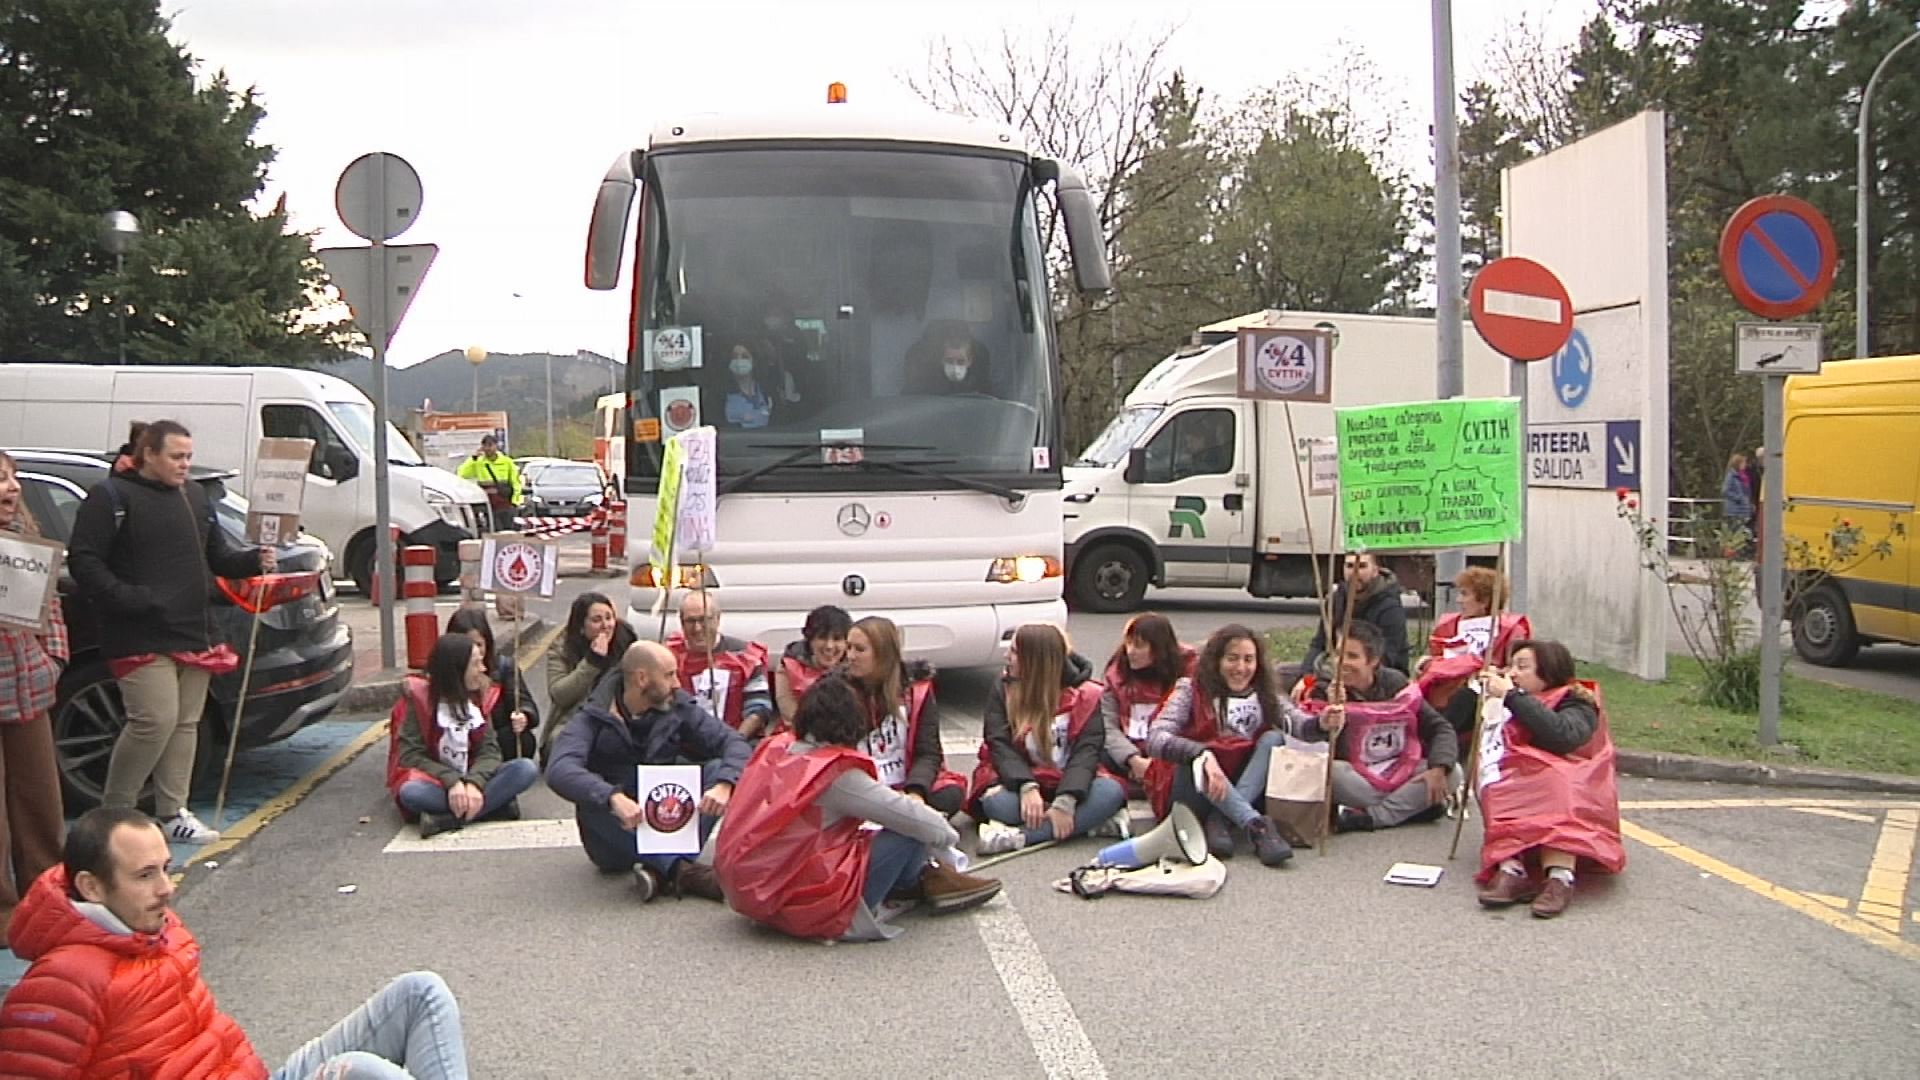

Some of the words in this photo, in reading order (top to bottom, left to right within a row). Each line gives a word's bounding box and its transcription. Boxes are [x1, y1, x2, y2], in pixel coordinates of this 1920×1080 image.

[1267, 368, 1304, 380] CVTTH
[1462, 417, 1511, 442] CVTTH
[1533, 457, 1584, 480] SALIDA
[1350, 488, 1372, 503] SOLO
